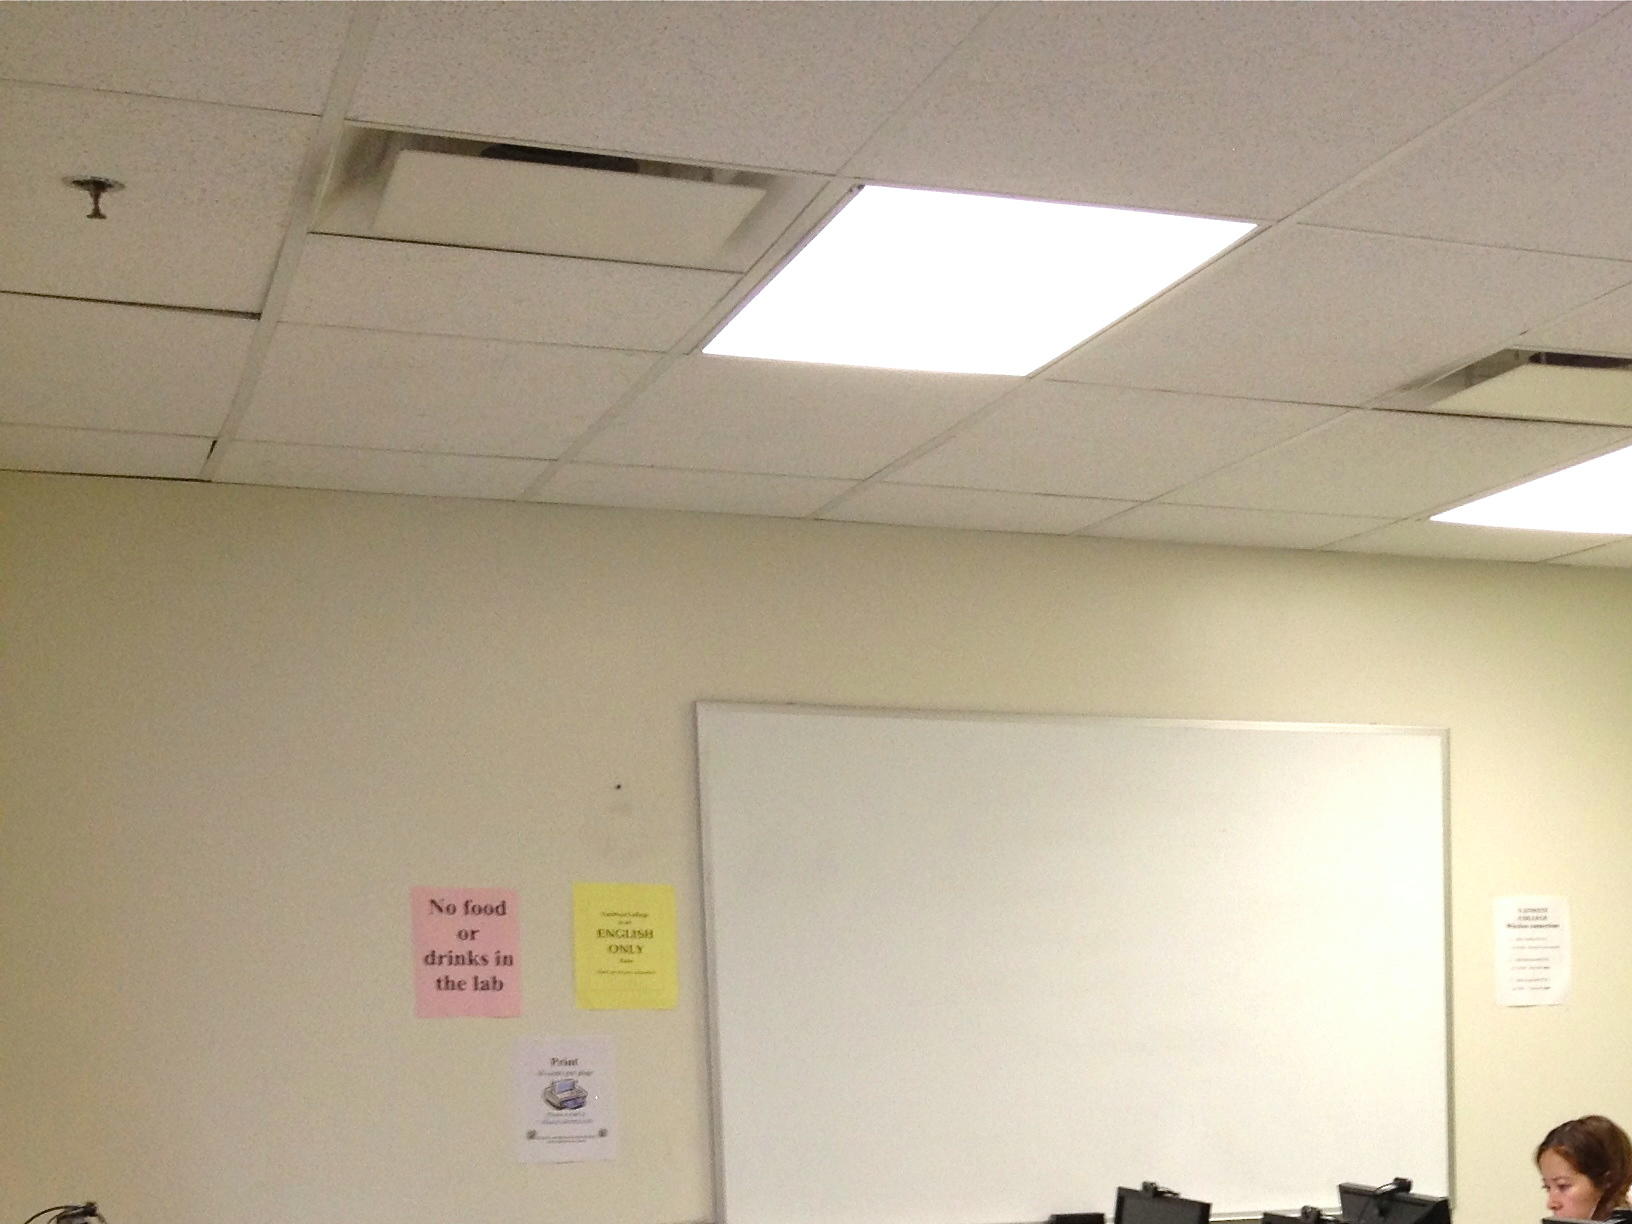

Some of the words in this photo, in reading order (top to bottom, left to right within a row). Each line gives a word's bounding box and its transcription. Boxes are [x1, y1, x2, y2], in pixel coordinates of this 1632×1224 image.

[429, 899, 456, 915] No
[463, 899, 507, 916] food
[457, 929, 480, 941] or
[596, 928, 655, 939] ENGLISH
[608, 945, 644, 954] ONLY
[424, 950, 489, 966] drinks
[494, 950, 514, 966] in
[436, 975, 466, 991] the
[473, 975, 504, 991] lab
[550, 1057, 579, 1066] Print
